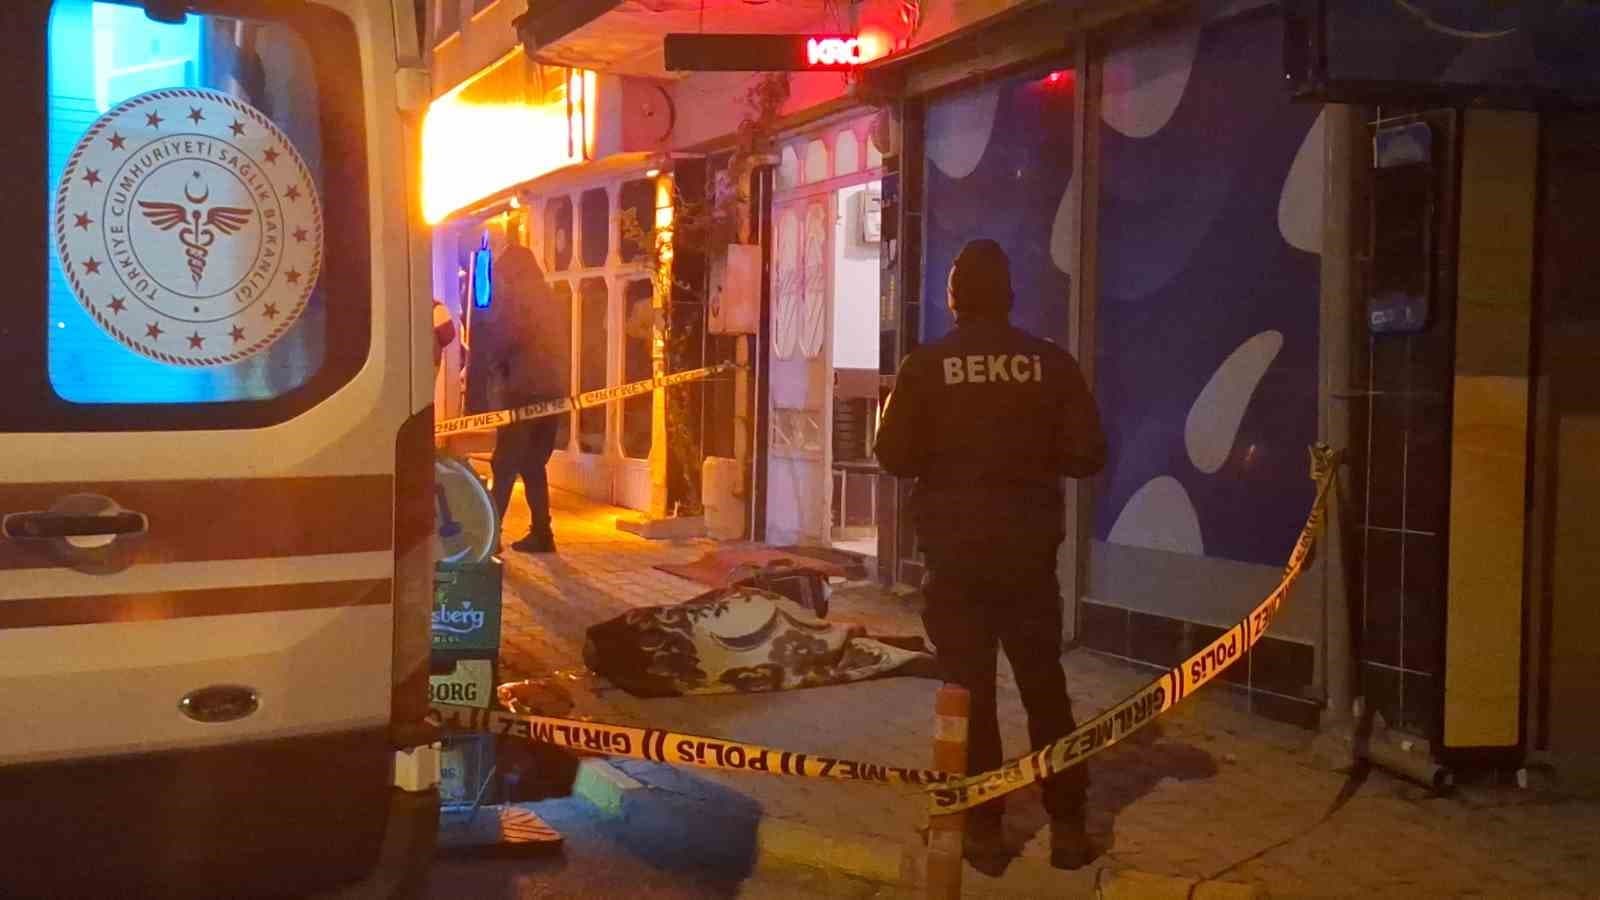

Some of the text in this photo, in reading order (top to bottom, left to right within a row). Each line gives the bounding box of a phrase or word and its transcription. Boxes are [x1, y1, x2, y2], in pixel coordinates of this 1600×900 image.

[109, 138, 280, 304] TÜRKİYE CUMHURİYETİ SAĞLIK BAKANLIĞI
[1190, 634, 1238, 683] POLİS
[676, 739, 769, 774] POLİS
[1062, 687, 1166, 765] GİRİLMEZ
